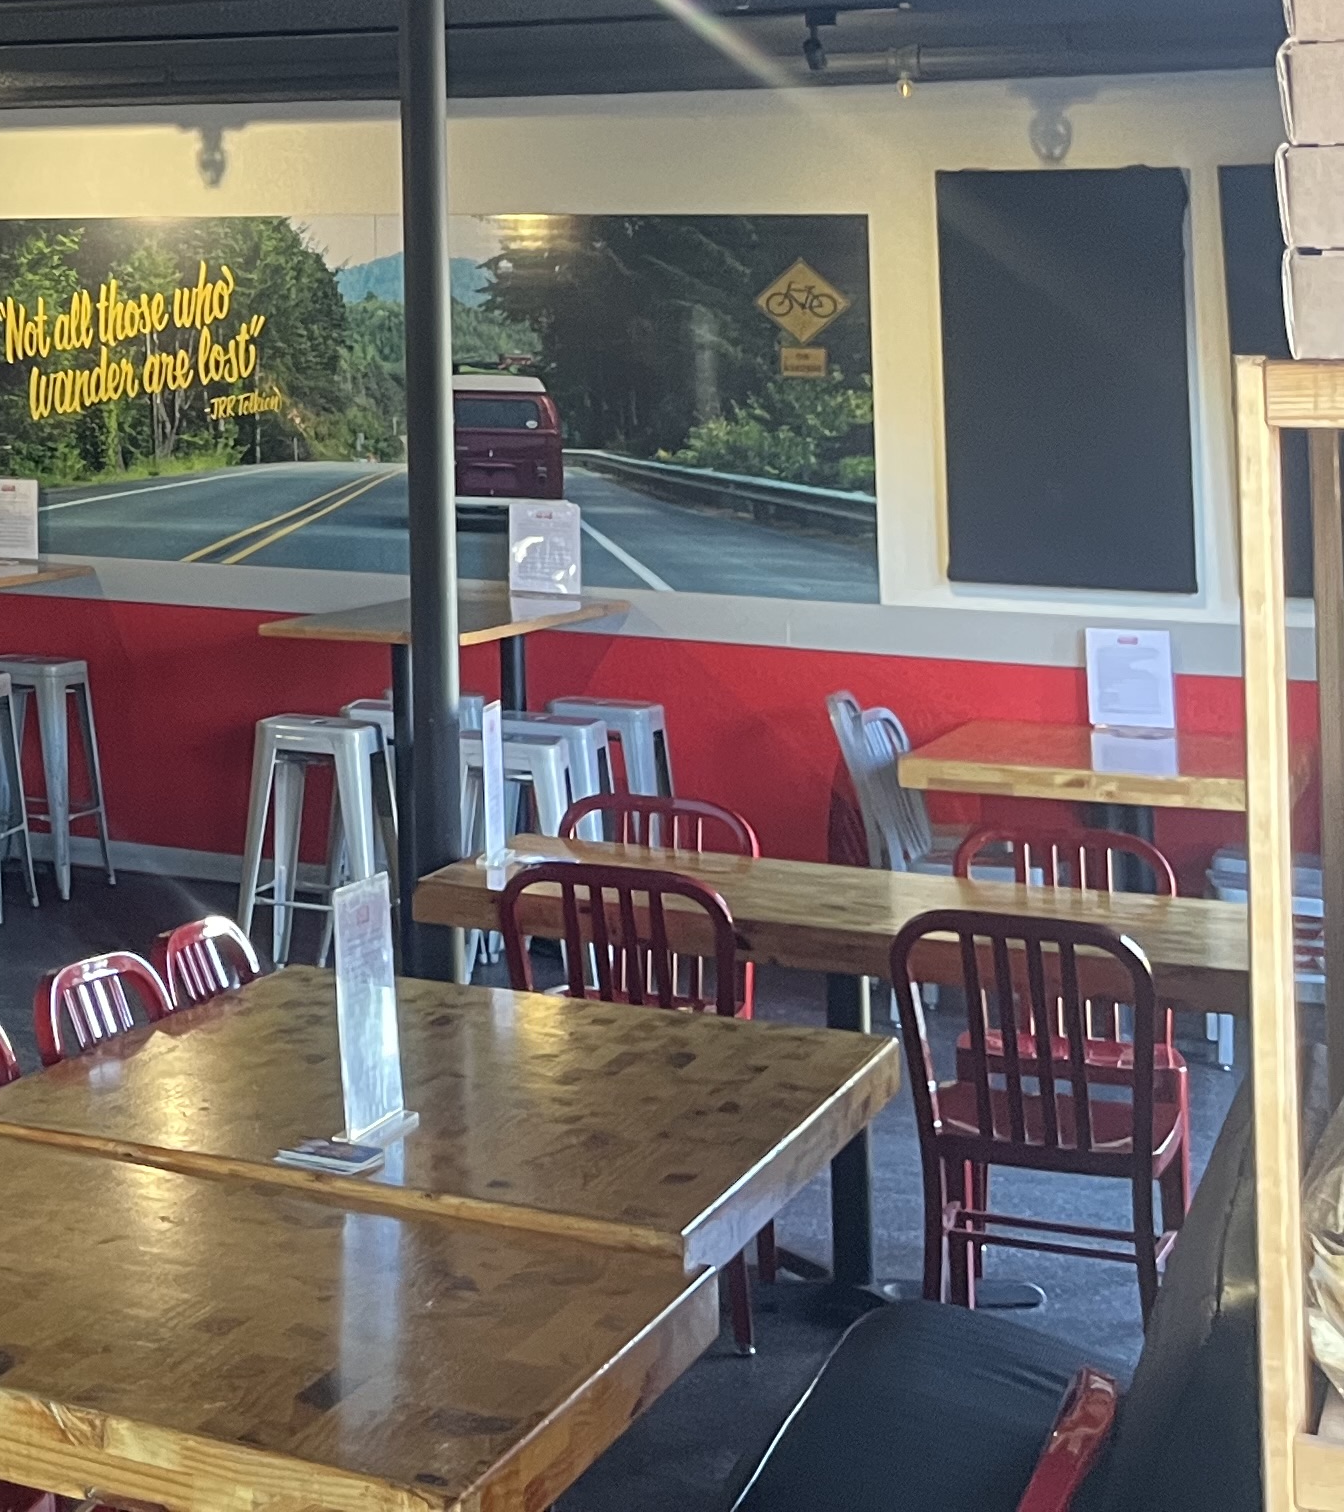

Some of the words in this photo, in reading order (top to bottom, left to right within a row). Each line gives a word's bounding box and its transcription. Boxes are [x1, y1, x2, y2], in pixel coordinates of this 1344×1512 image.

[54, 289, 94, 351] all
[96, 278, 170, 347] those
[173, 259, 236, 330] who
[29, 345, 140, 421] wander
[143, 349, 194, 394] are
